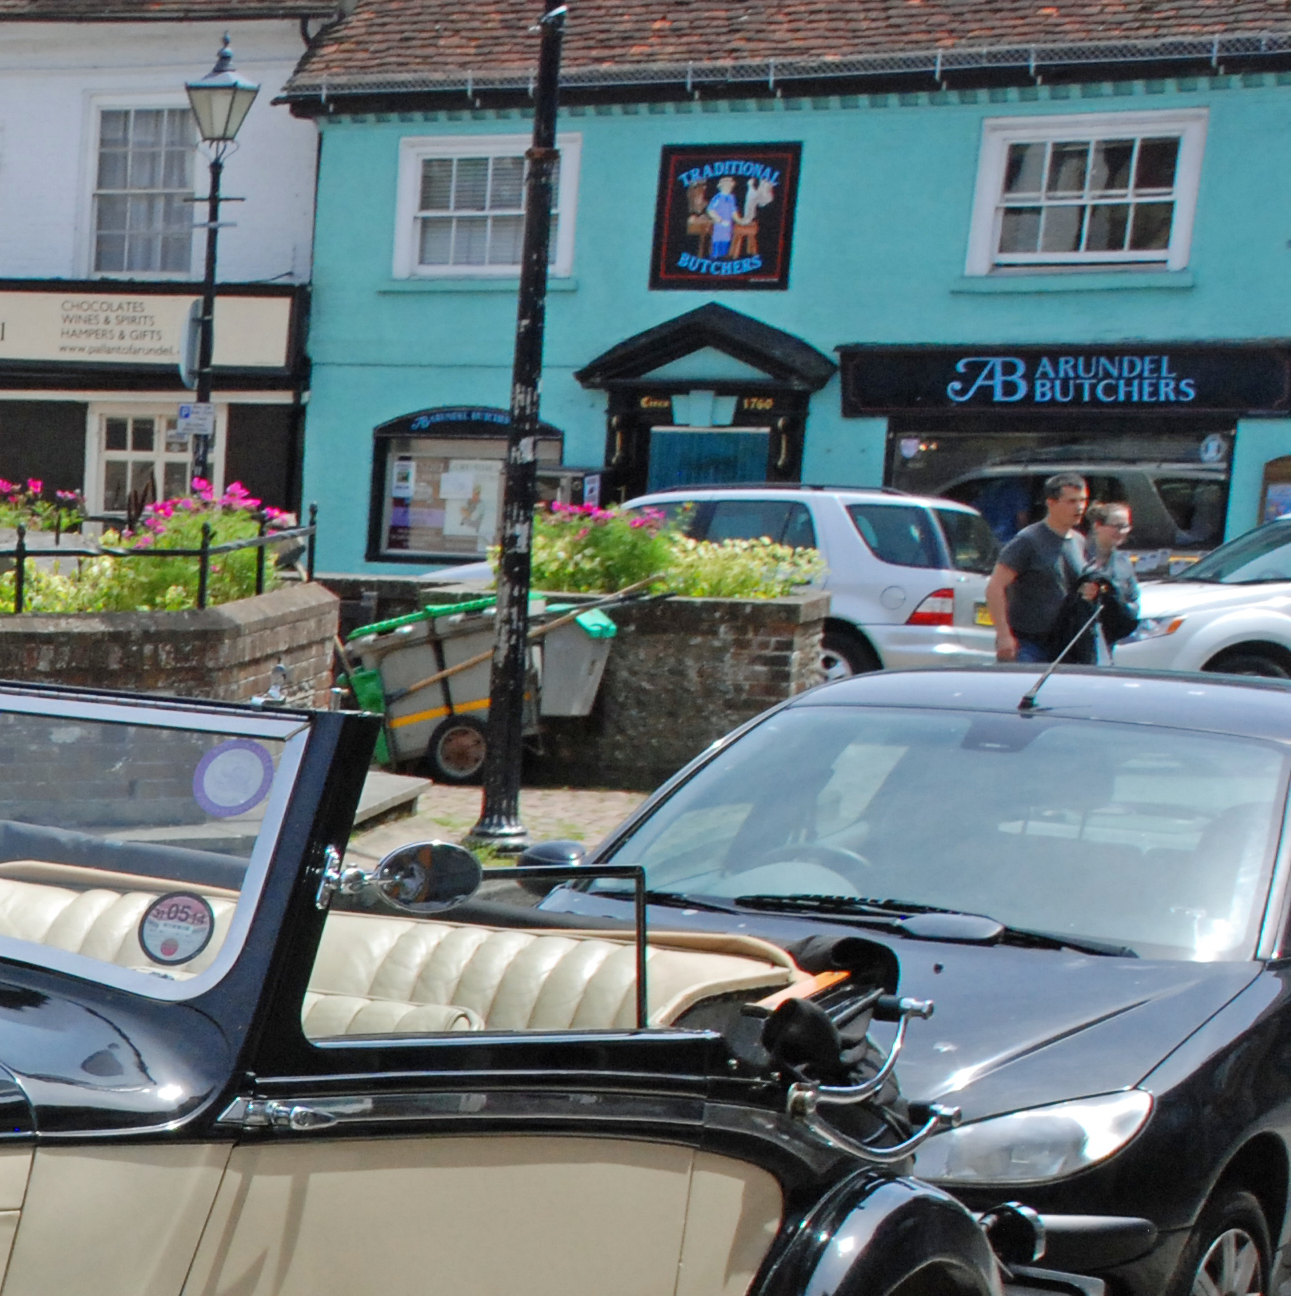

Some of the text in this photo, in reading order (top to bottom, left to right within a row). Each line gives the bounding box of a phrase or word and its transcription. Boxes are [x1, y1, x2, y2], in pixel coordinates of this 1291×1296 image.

[677, 160, 780, 188] TRADITIONAL
[677, 252, 763, 275] BUTCHERS
[61, 300, 145, 313] CHOCOLATES
[61, 313, 156, 327] WINES & SPIRITS
[61, 328, 163, 342] HAMPERS & GIFTS
[1034, 355, 1177, 379] ARUNDEL
[1034, 379, 1197, 402] BUTCHERS
[167, 903, 192, 922] 05
